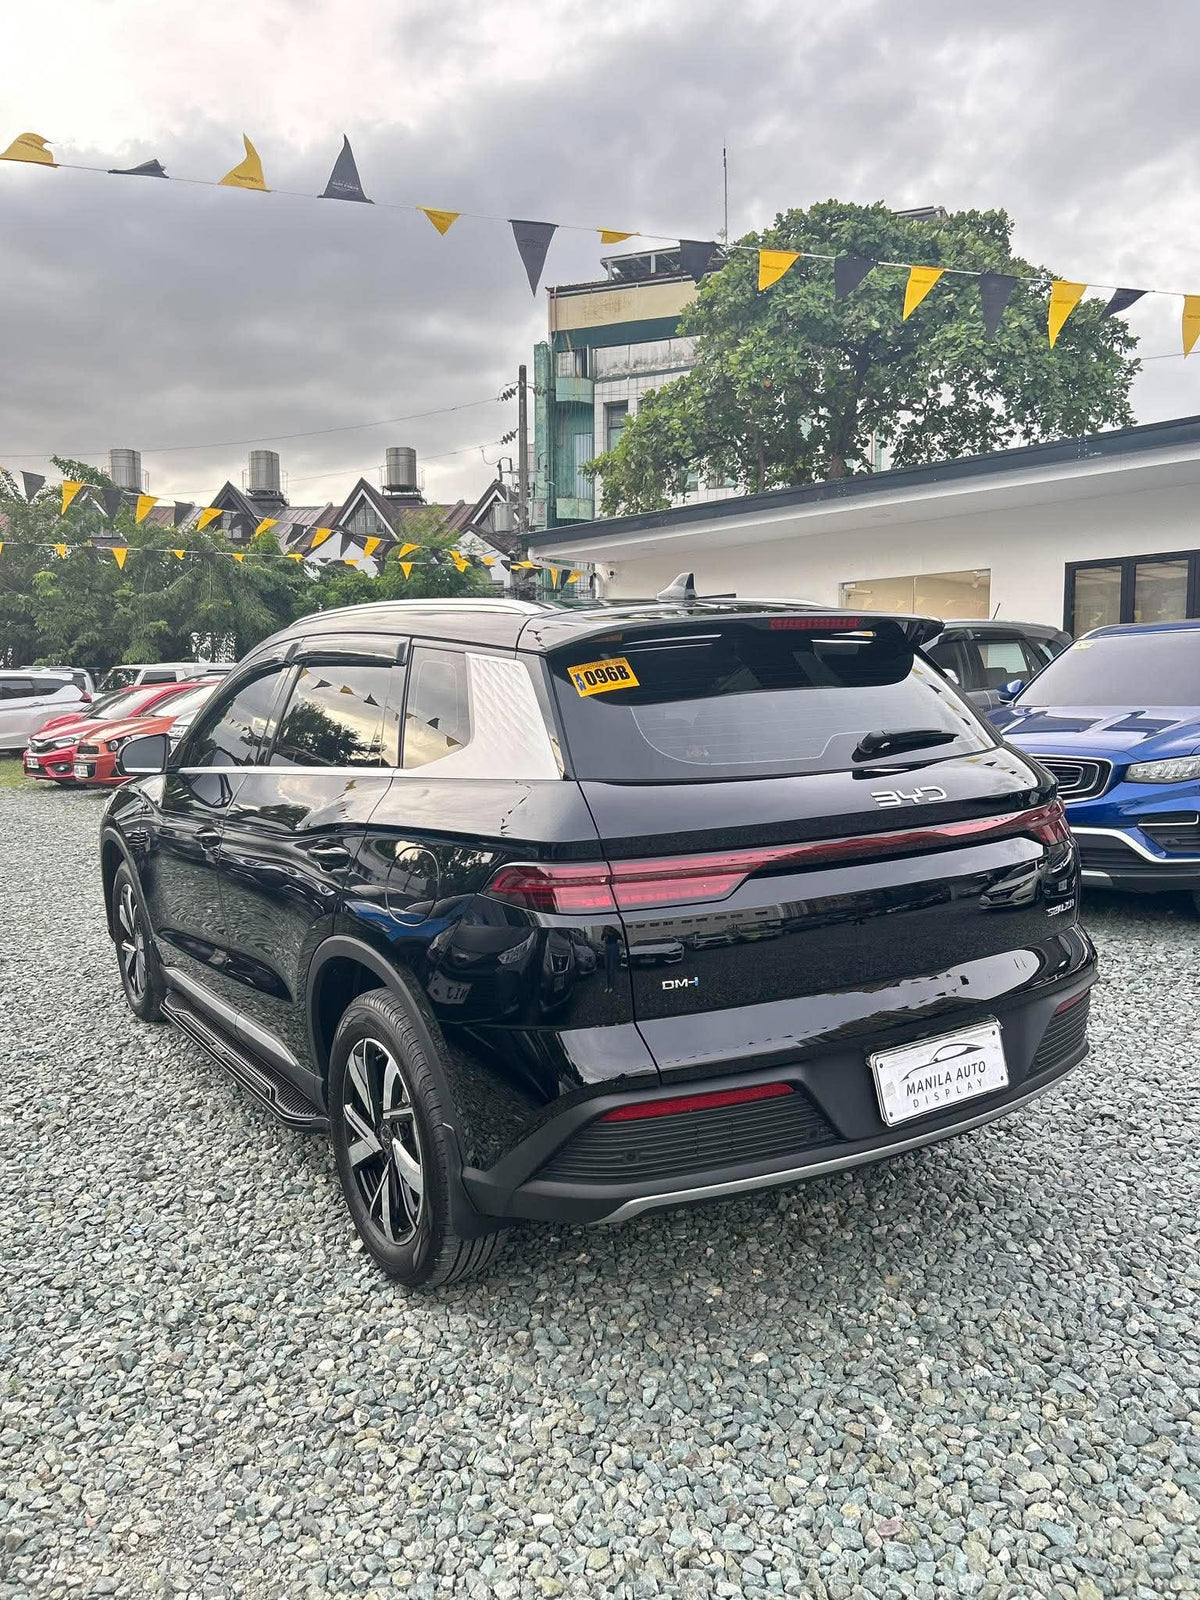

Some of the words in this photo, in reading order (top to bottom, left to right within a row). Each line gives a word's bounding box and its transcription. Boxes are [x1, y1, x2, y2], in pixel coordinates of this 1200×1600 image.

[584, 665, 630, 686] 096B
[871, 785, 947, 807] BYD
[906, 1071, 952, 1096] MANILA
[956, 1060, 986, 1080] AUTO
[913, 1078, 983, 1108] DISPLAY
